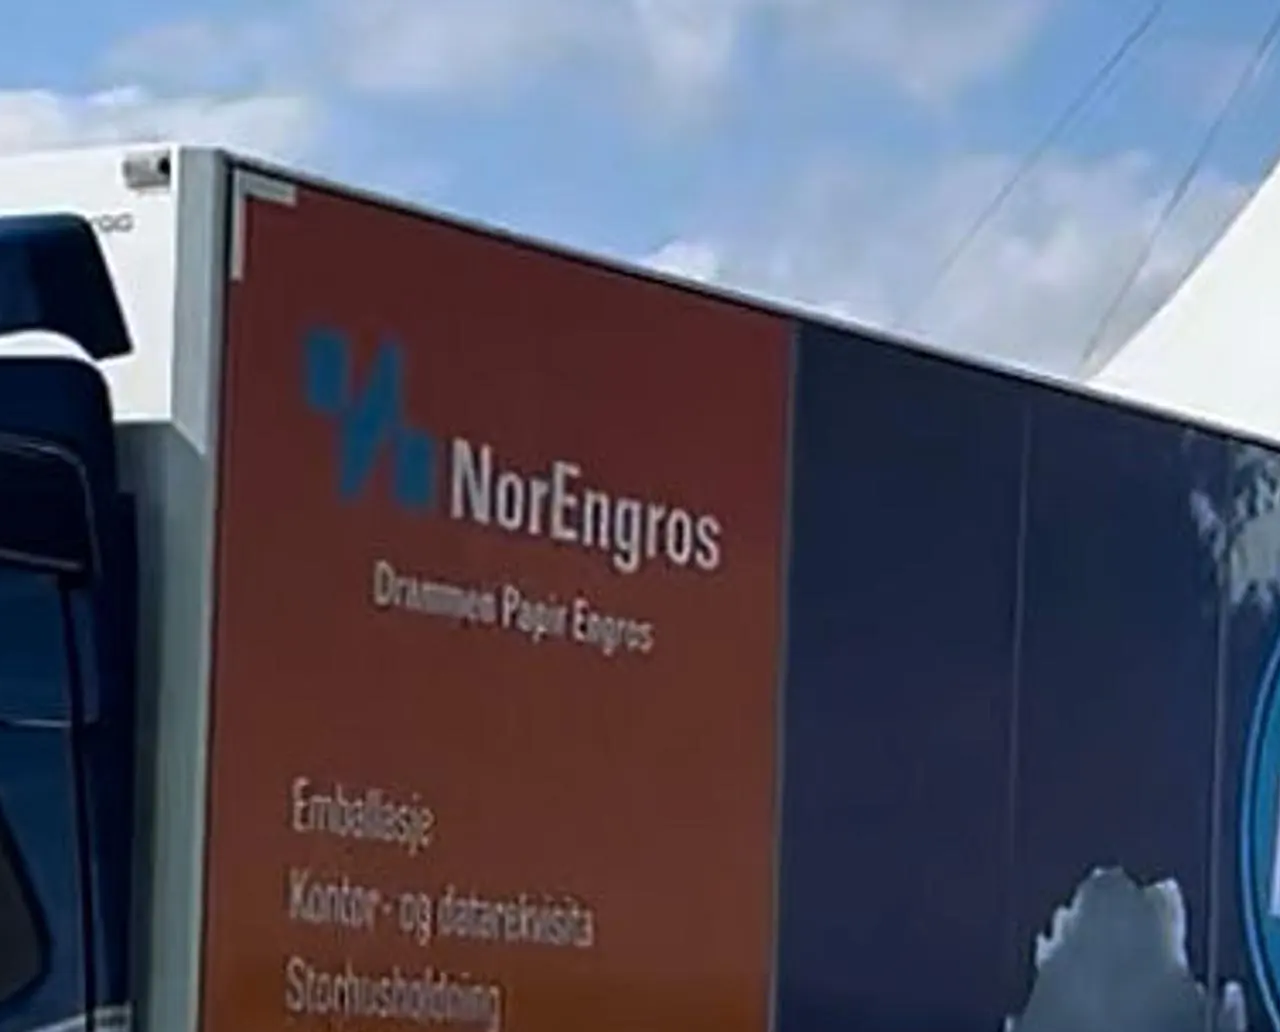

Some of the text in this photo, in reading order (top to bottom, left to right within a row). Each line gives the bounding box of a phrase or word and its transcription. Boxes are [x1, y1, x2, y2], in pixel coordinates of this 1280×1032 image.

[451, 437, 722, 573] NorEngros
[503, 584, 568, 644] Papir
[572, 598, 654, 656] Engros
[292, 776, 434, 856] Emballasje
[399, 892, 431, 947] og
